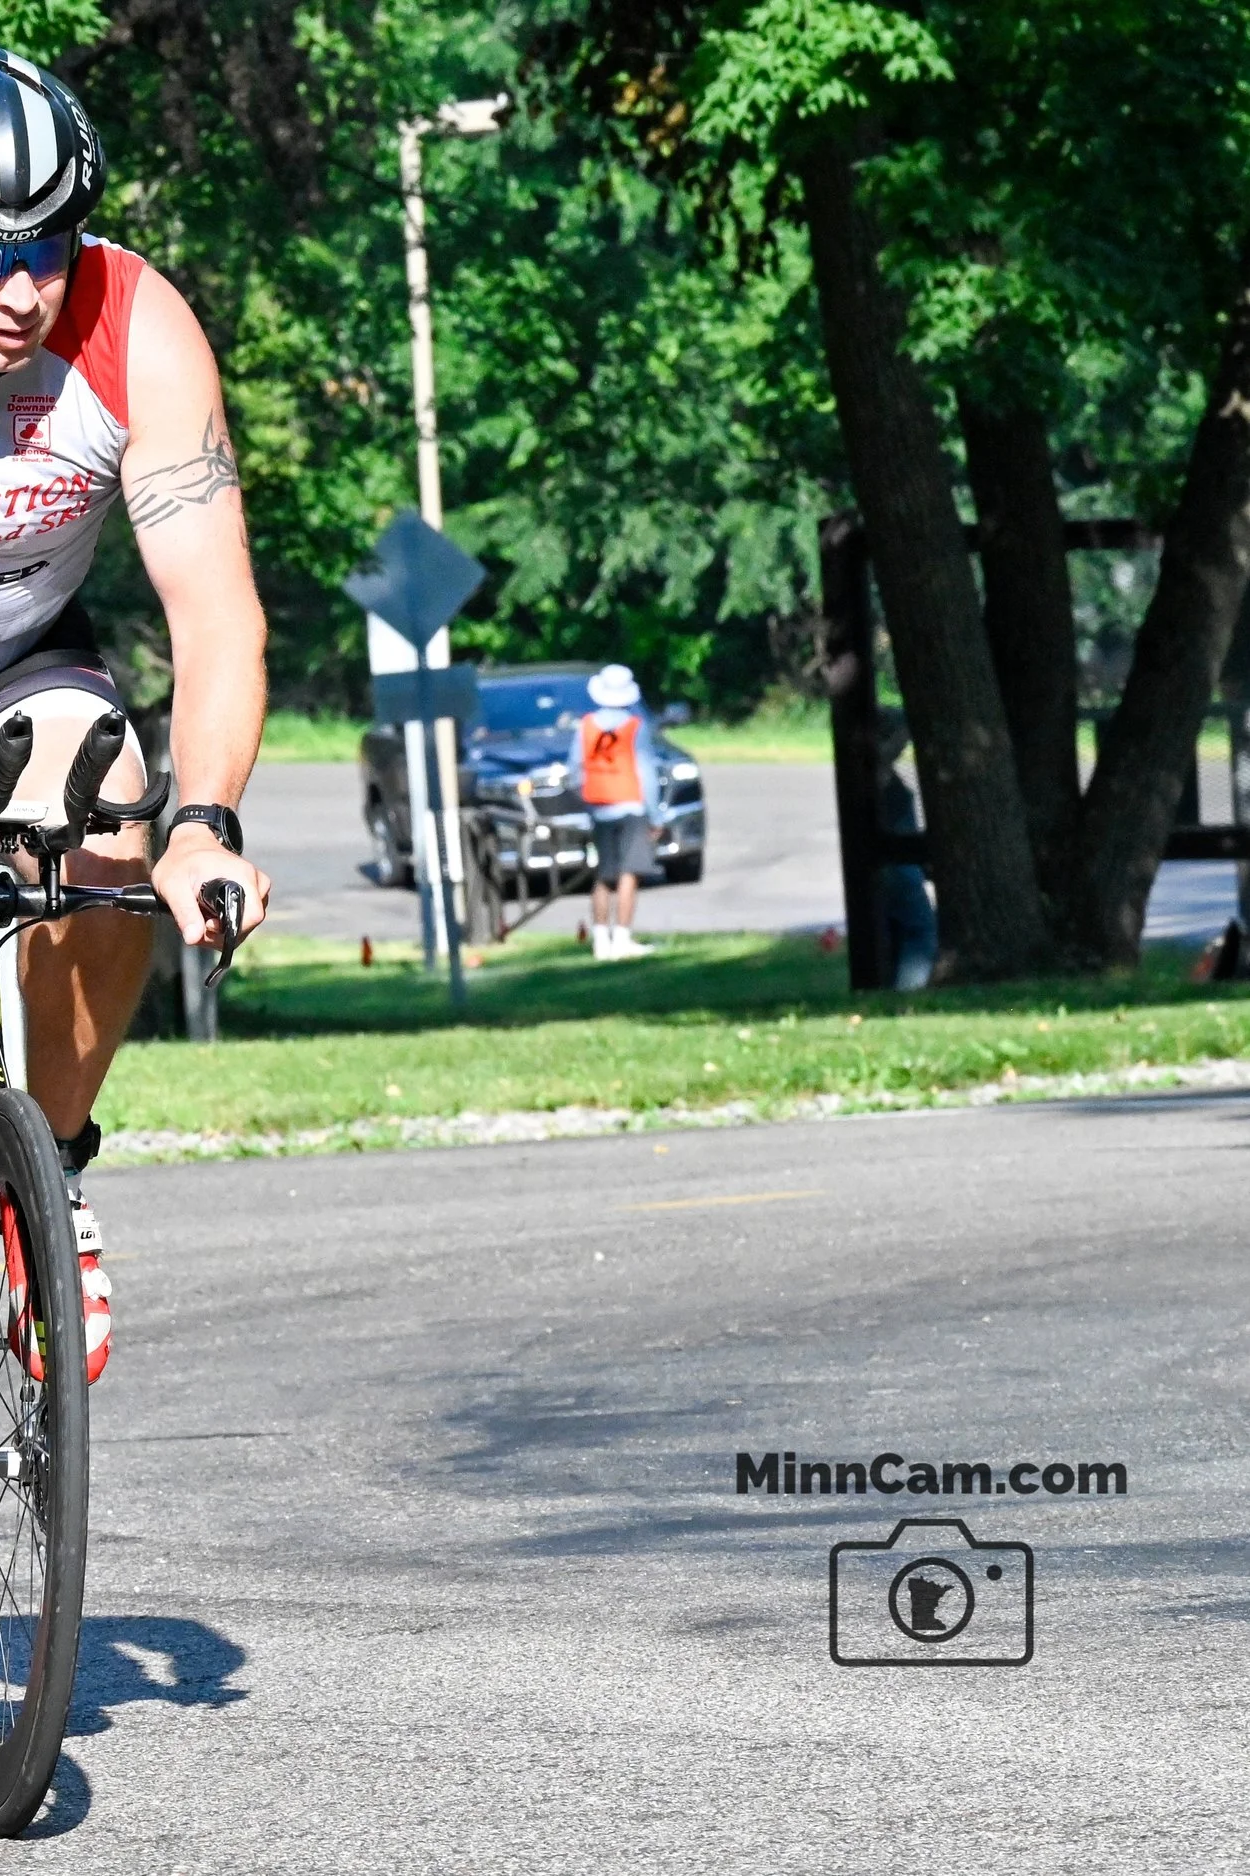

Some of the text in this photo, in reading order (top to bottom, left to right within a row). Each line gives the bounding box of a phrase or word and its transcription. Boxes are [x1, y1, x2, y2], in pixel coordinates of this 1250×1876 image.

[55, 85, 93, 191] RUDY
[10, 394, 56, 403] Tammie
[13, 447, 52, 458] Agency
